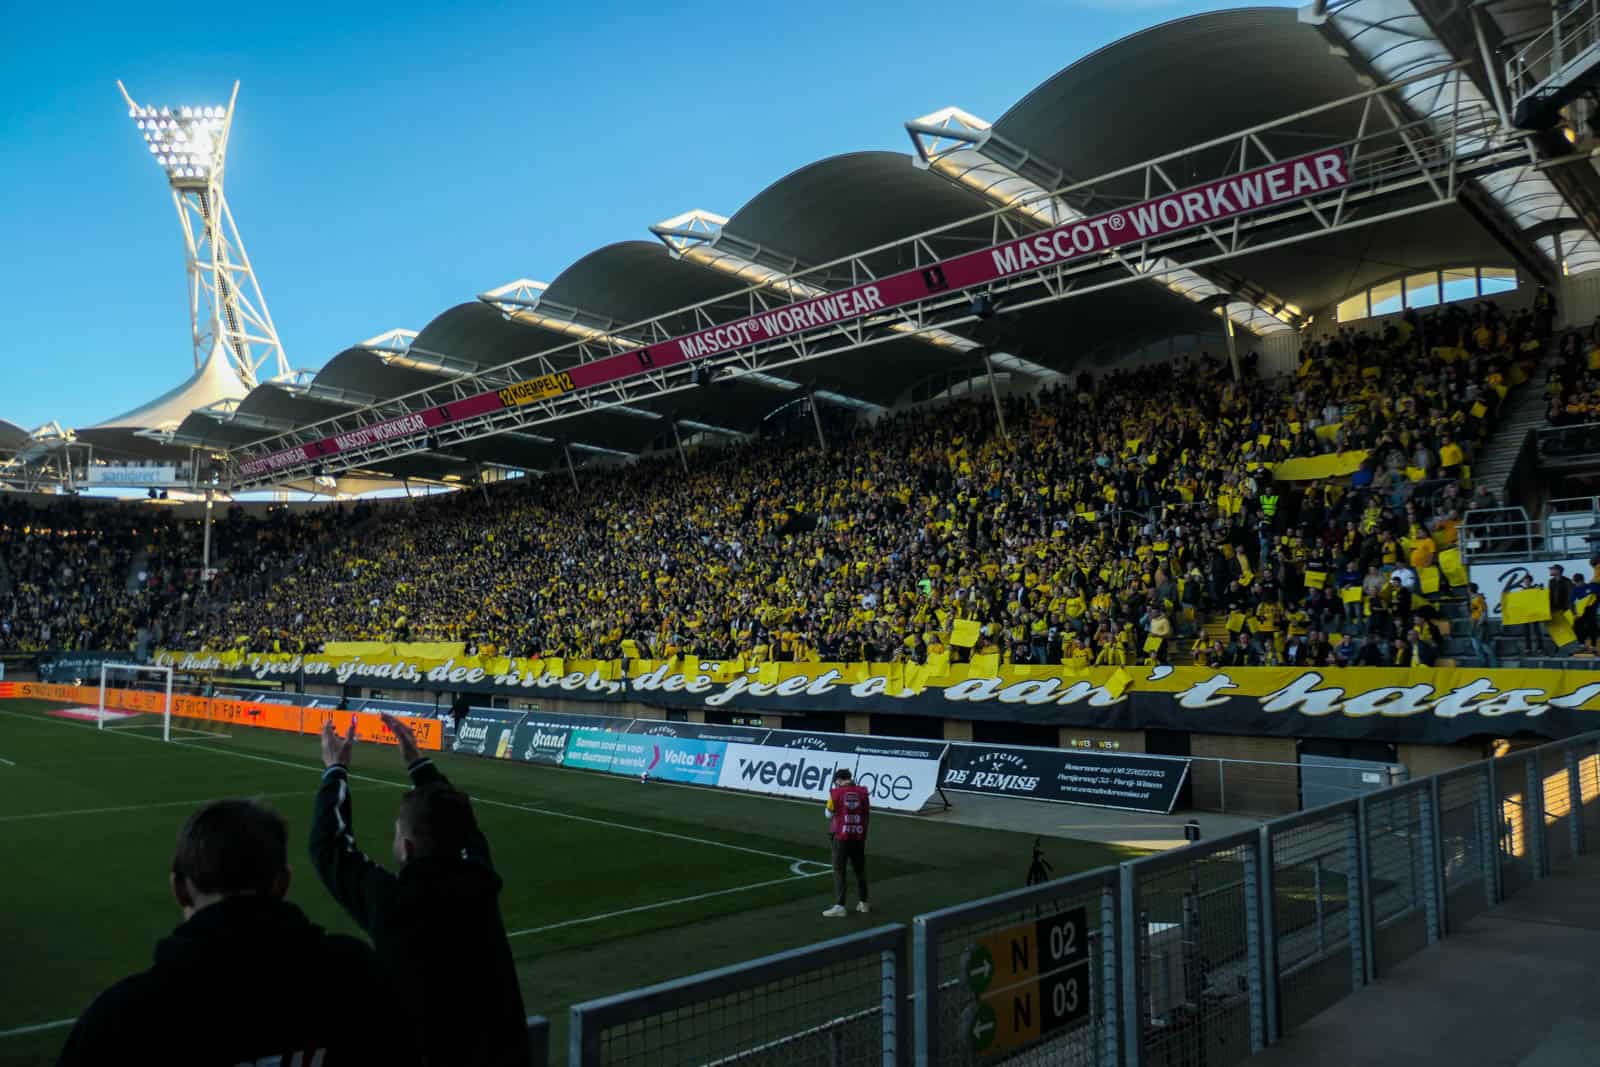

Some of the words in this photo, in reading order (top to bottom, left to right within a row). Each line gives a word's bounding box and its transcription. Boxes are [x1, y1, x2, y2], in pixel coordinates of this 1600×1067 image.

[1128, 153, 1347, 237] WORKWEAR
[760, 285, 884, 337] WORKWEAR
[512, 379, 559, 401] KOEMPEL
[556, 373, 575, 393] 12
[372, 414, 428, 440] WORKWEAR
[459, 721, 488, 739] Brand
[532, 728, 567, 748] Brand
[943, 768, 967, 784] DE
[970, 770, 1040, 792] REMISE
[1011, 935, 1028, 974] N
[1050, 922, 1076, 959] 02
[1013, 992, 1031, 1032] N
[1052, 977, 1078, 1017] 03
